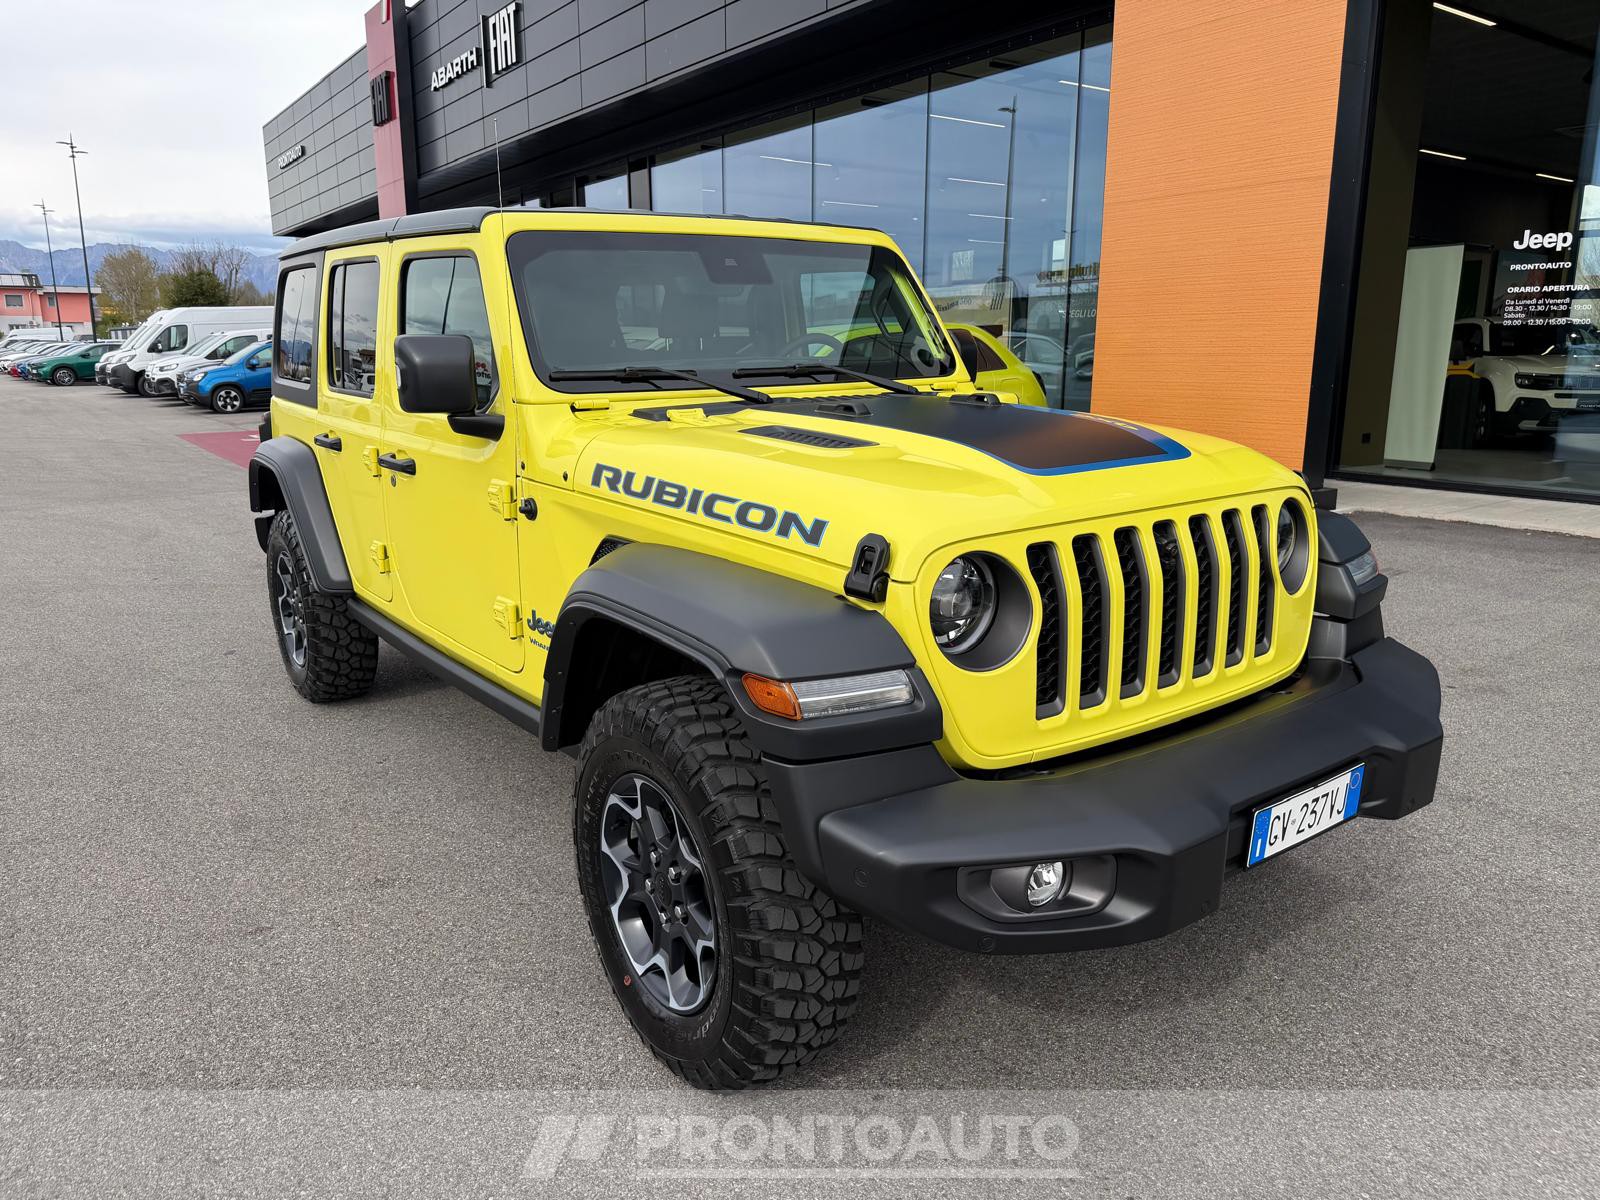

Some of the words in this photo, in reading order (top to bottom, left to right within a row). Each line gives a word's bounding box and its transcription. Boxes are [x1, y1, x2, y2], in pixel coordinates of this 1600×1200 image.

[488, 2, 516, 74] FIAT
[431, 46, 477, 91] ABARTH
[1513, 229, 1573, 251] Jeep
[1510, 262, 1572, 271] PRONTOAUTO
[1542, 284, 1590, 292] APERTURA
[591, 462, 830, 548] RUBICON
[1269, 808, 1292, 846] GV
[1296, 782, 1350, 835] 237VJ
